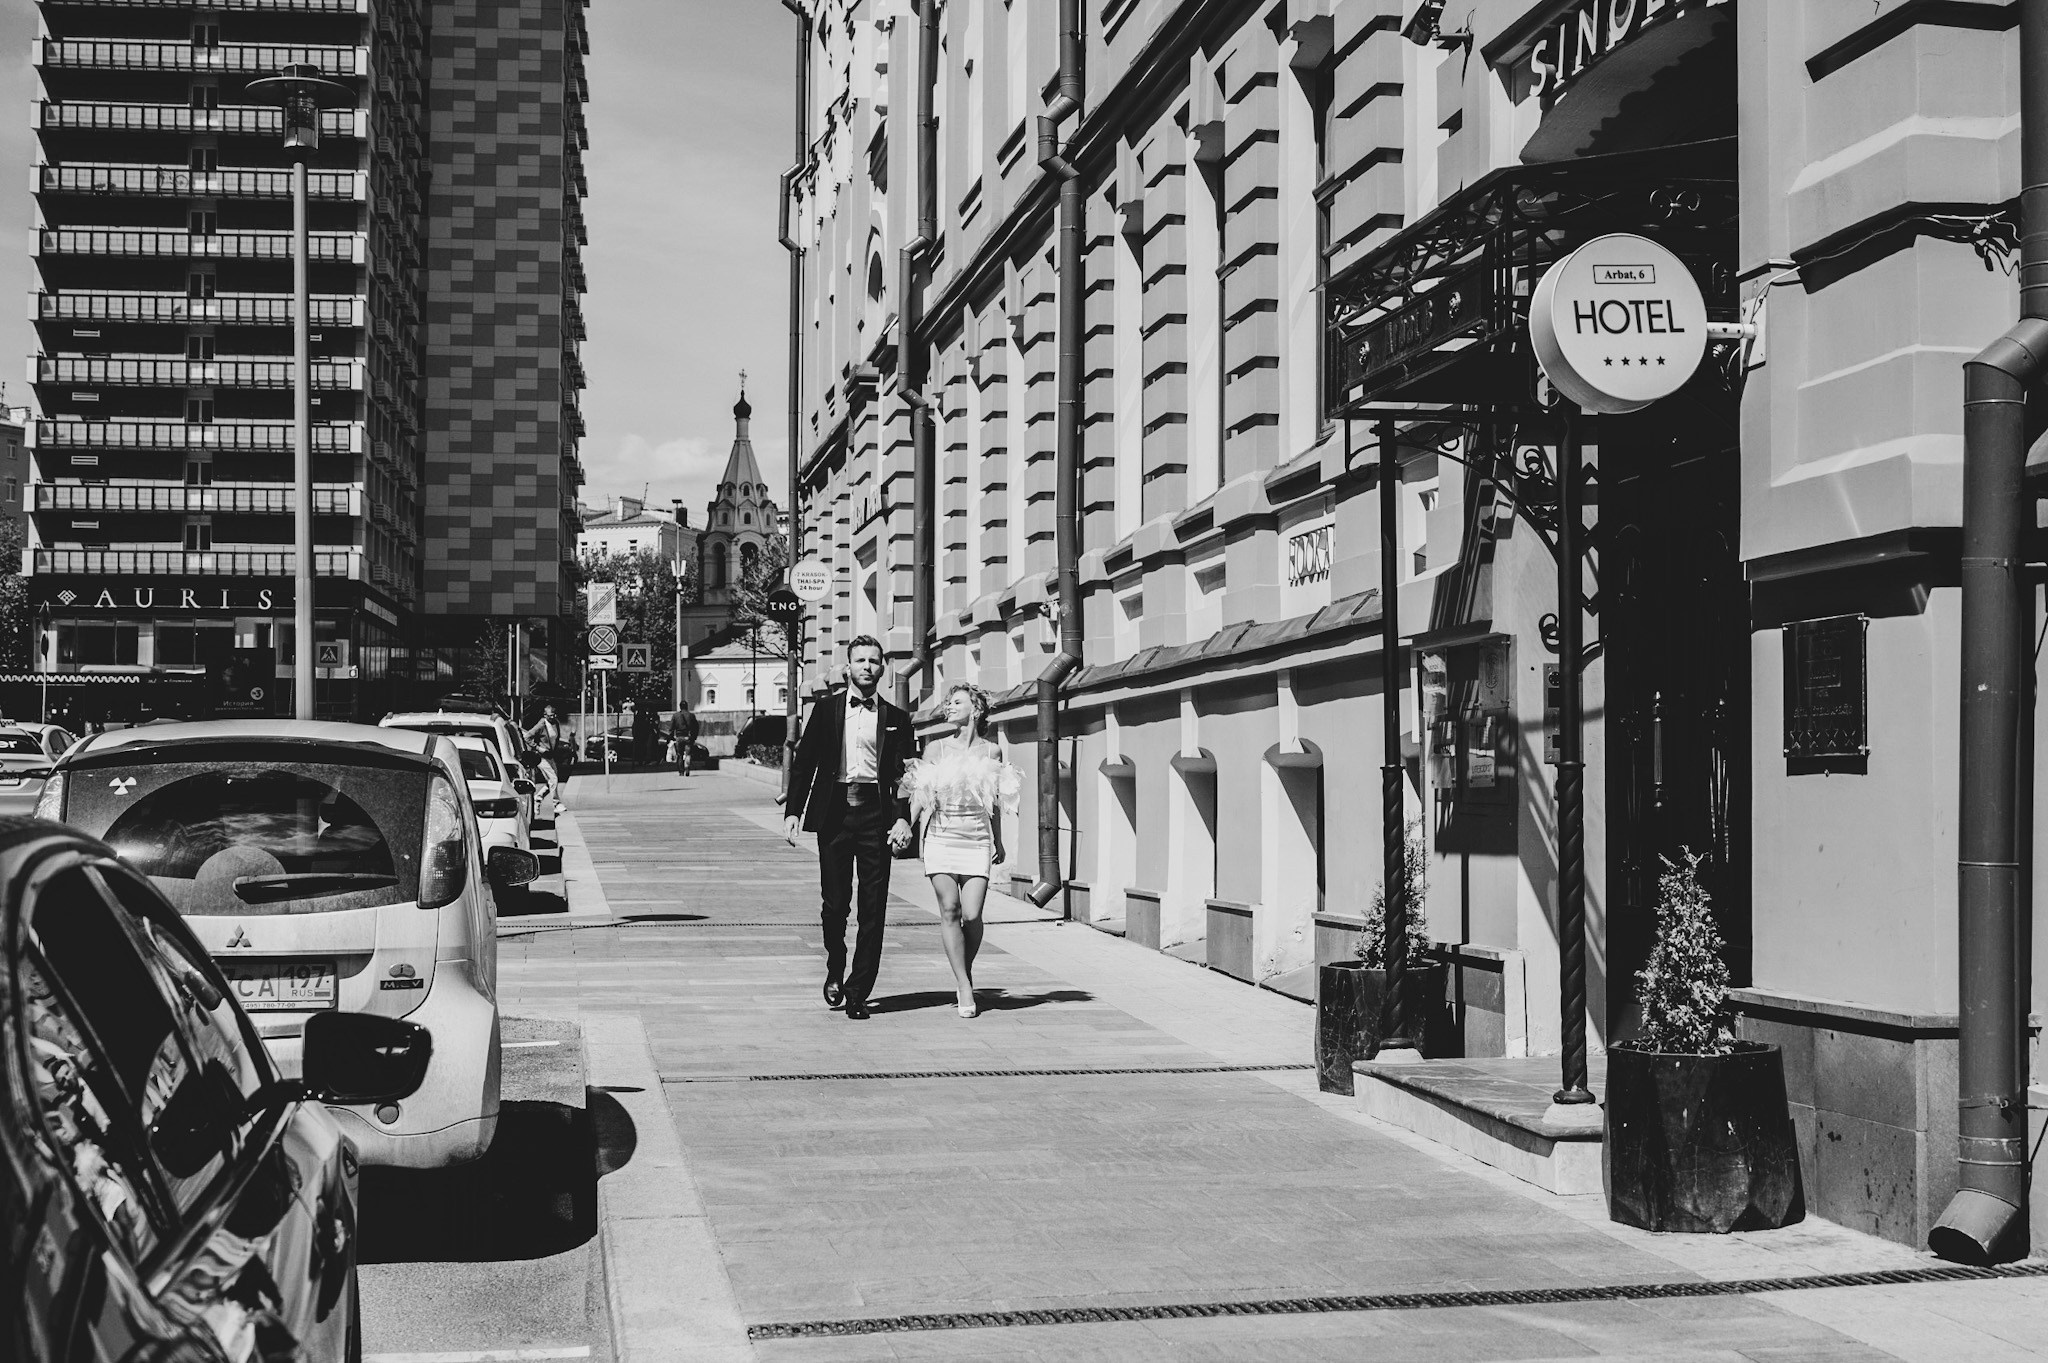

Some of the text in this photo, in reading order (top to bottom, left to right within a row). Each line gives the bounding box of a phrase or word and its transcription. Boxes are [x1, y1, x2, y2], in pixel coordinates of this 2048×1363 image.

[1604, 269, 1645, 280] Arbat, 6
[1573, 299, 1685, 334] HOTEL
[94, 587, 273, 610] AURIS
[283, 965, 326, 988] 197
[291, 989, 314, 997] RUS
